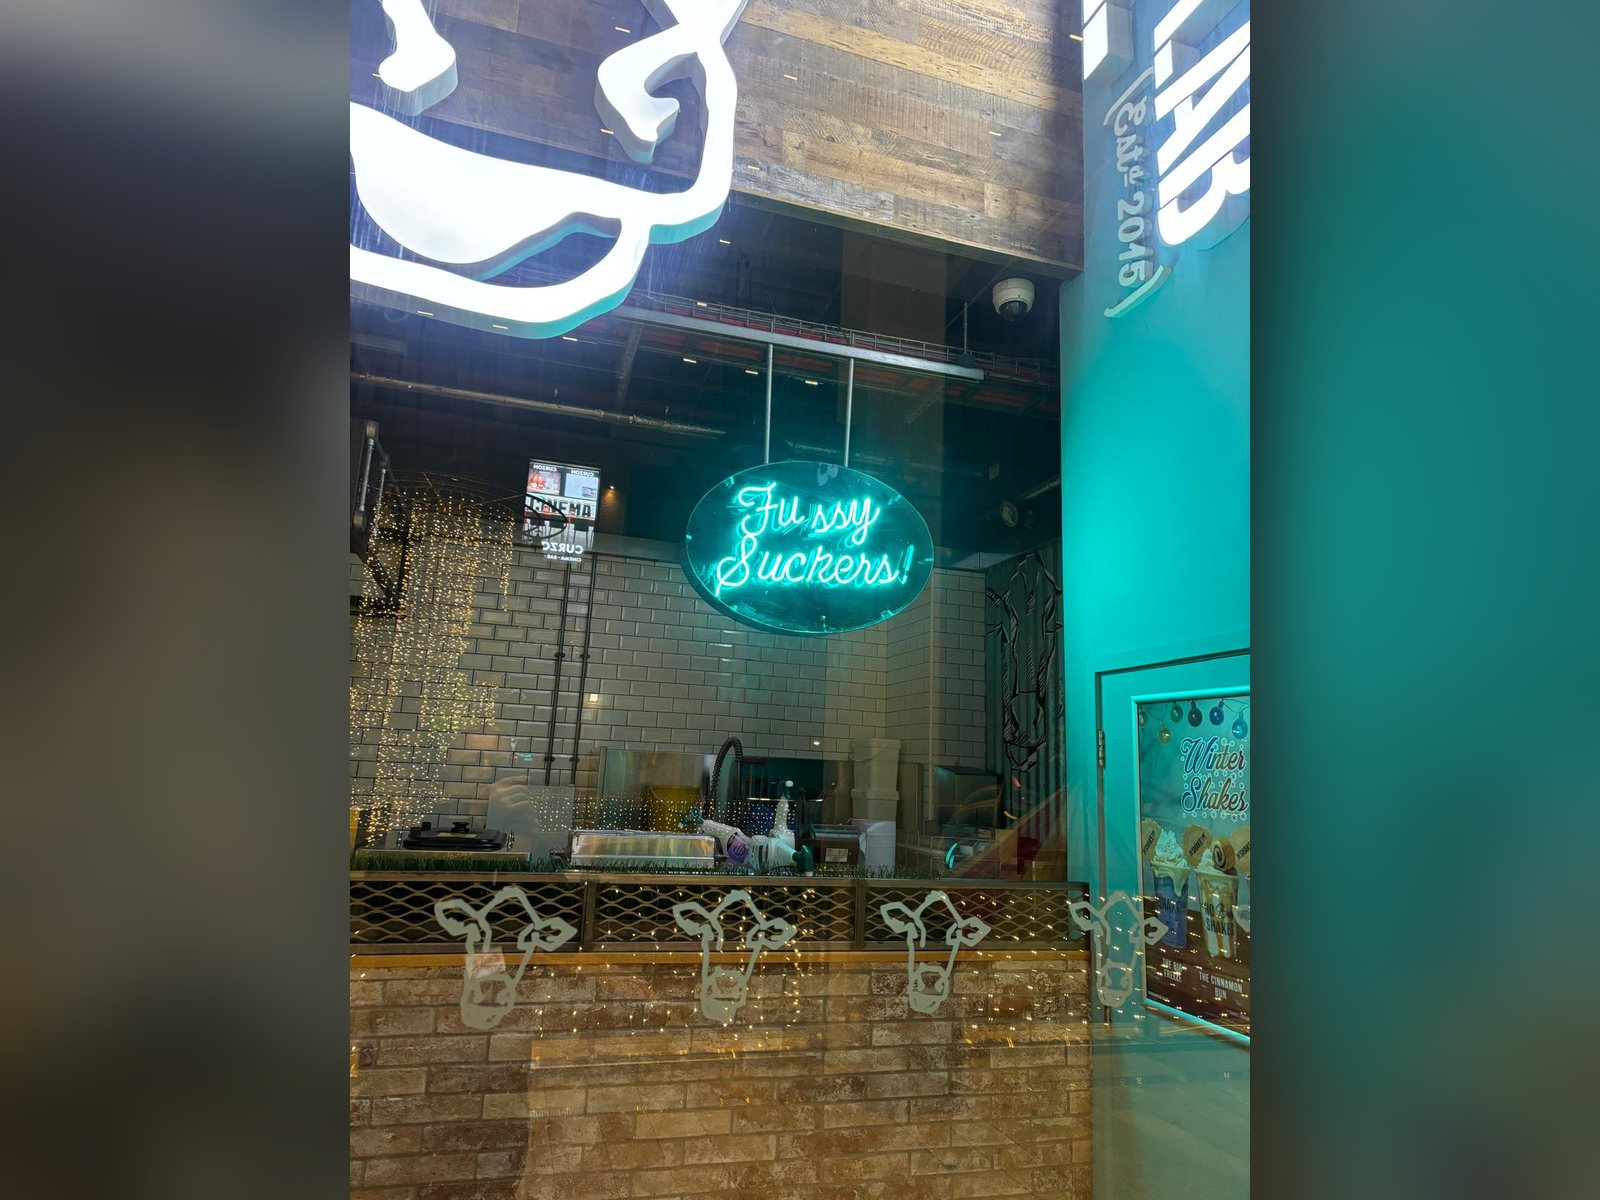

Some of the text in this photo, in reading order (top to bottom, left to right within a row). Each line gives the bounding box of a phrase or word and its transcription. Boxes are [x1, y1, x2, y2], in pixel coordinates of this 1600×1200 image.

[714, 533, 915, 597] Suckers!
[1181, 735, 1246, 774] Winter
[1181, 775, 1249, 812] Shakes
[1199, 971, 1243, 993] THE CINNAMON
[1214, 987, 1227, 999] BUN
